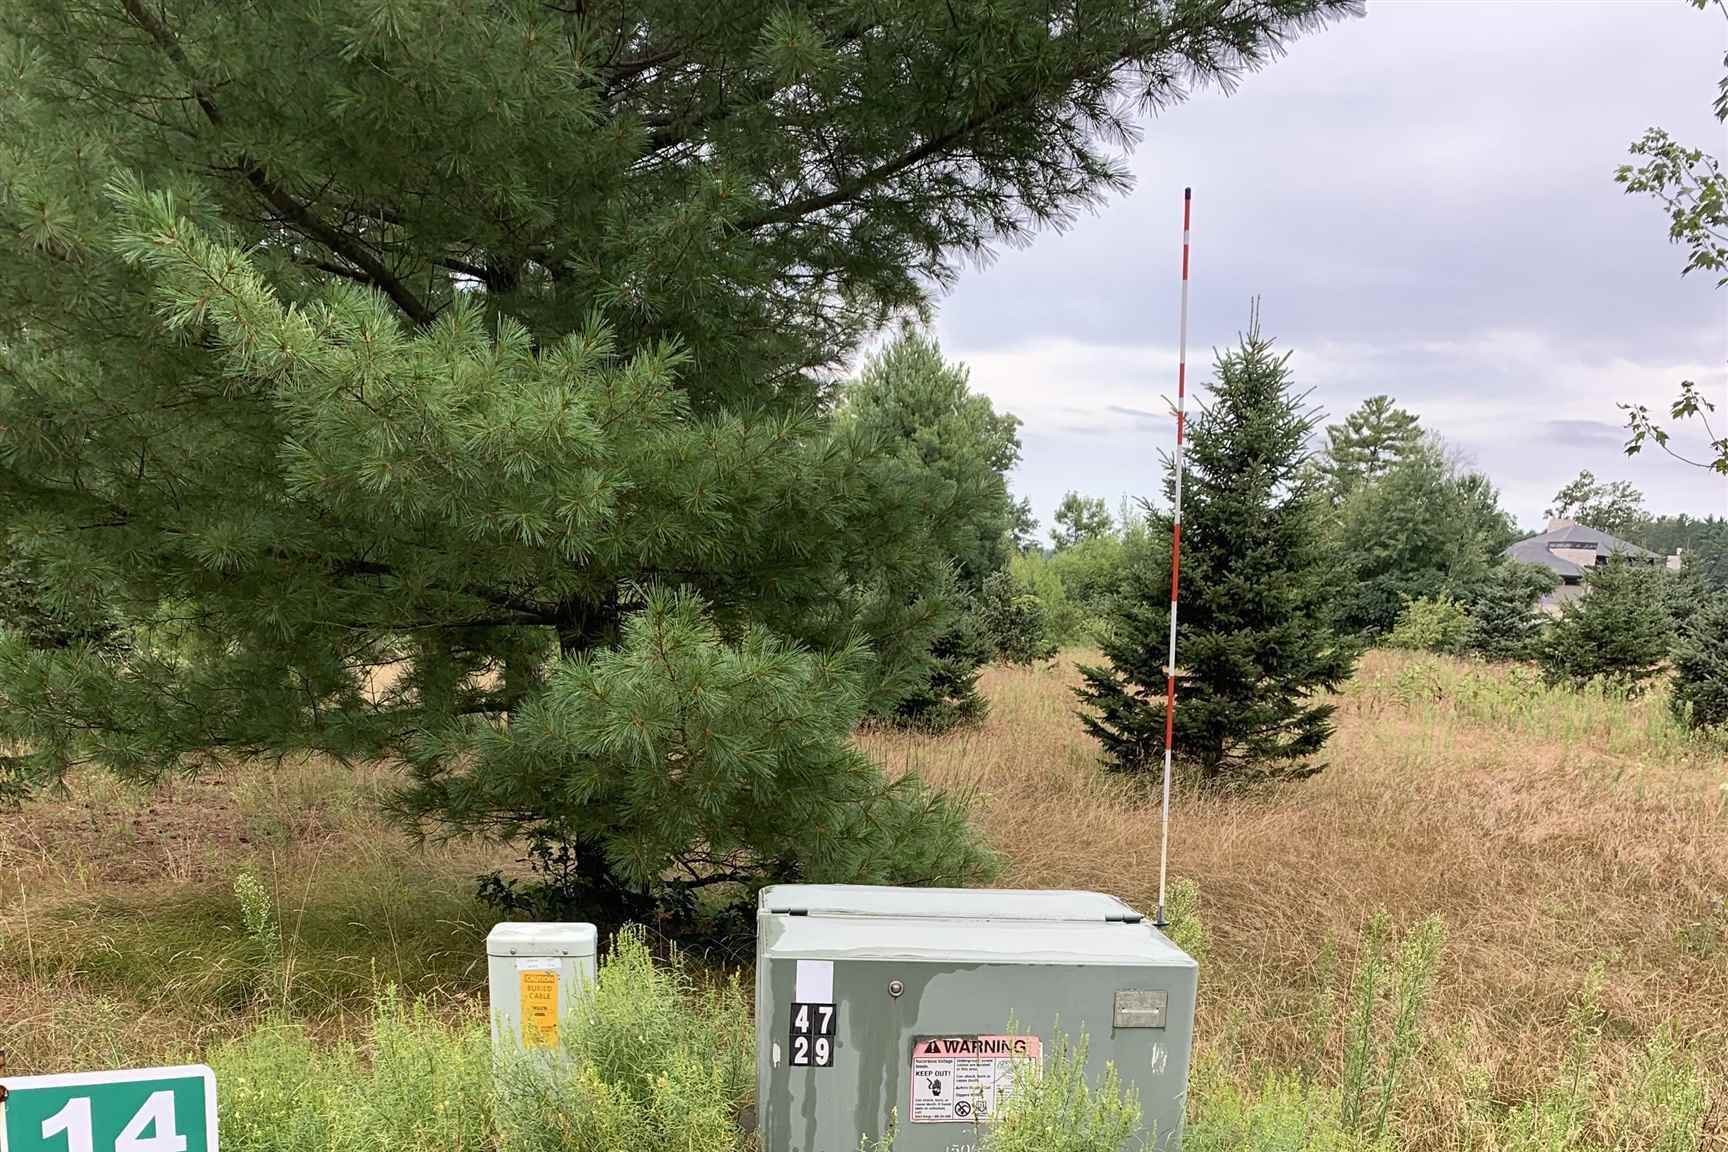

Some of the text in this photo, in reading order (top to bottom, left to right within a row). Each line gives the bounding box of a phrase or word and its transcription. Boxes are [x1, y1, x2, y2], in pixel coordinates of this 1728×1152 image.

[528, 992, 552, 1000] CABLE
[794, 1004, 833, 1034] 47
[794, 1036, 830, 1065] 29
[943, 1039, 1026, 1054] WARNING
